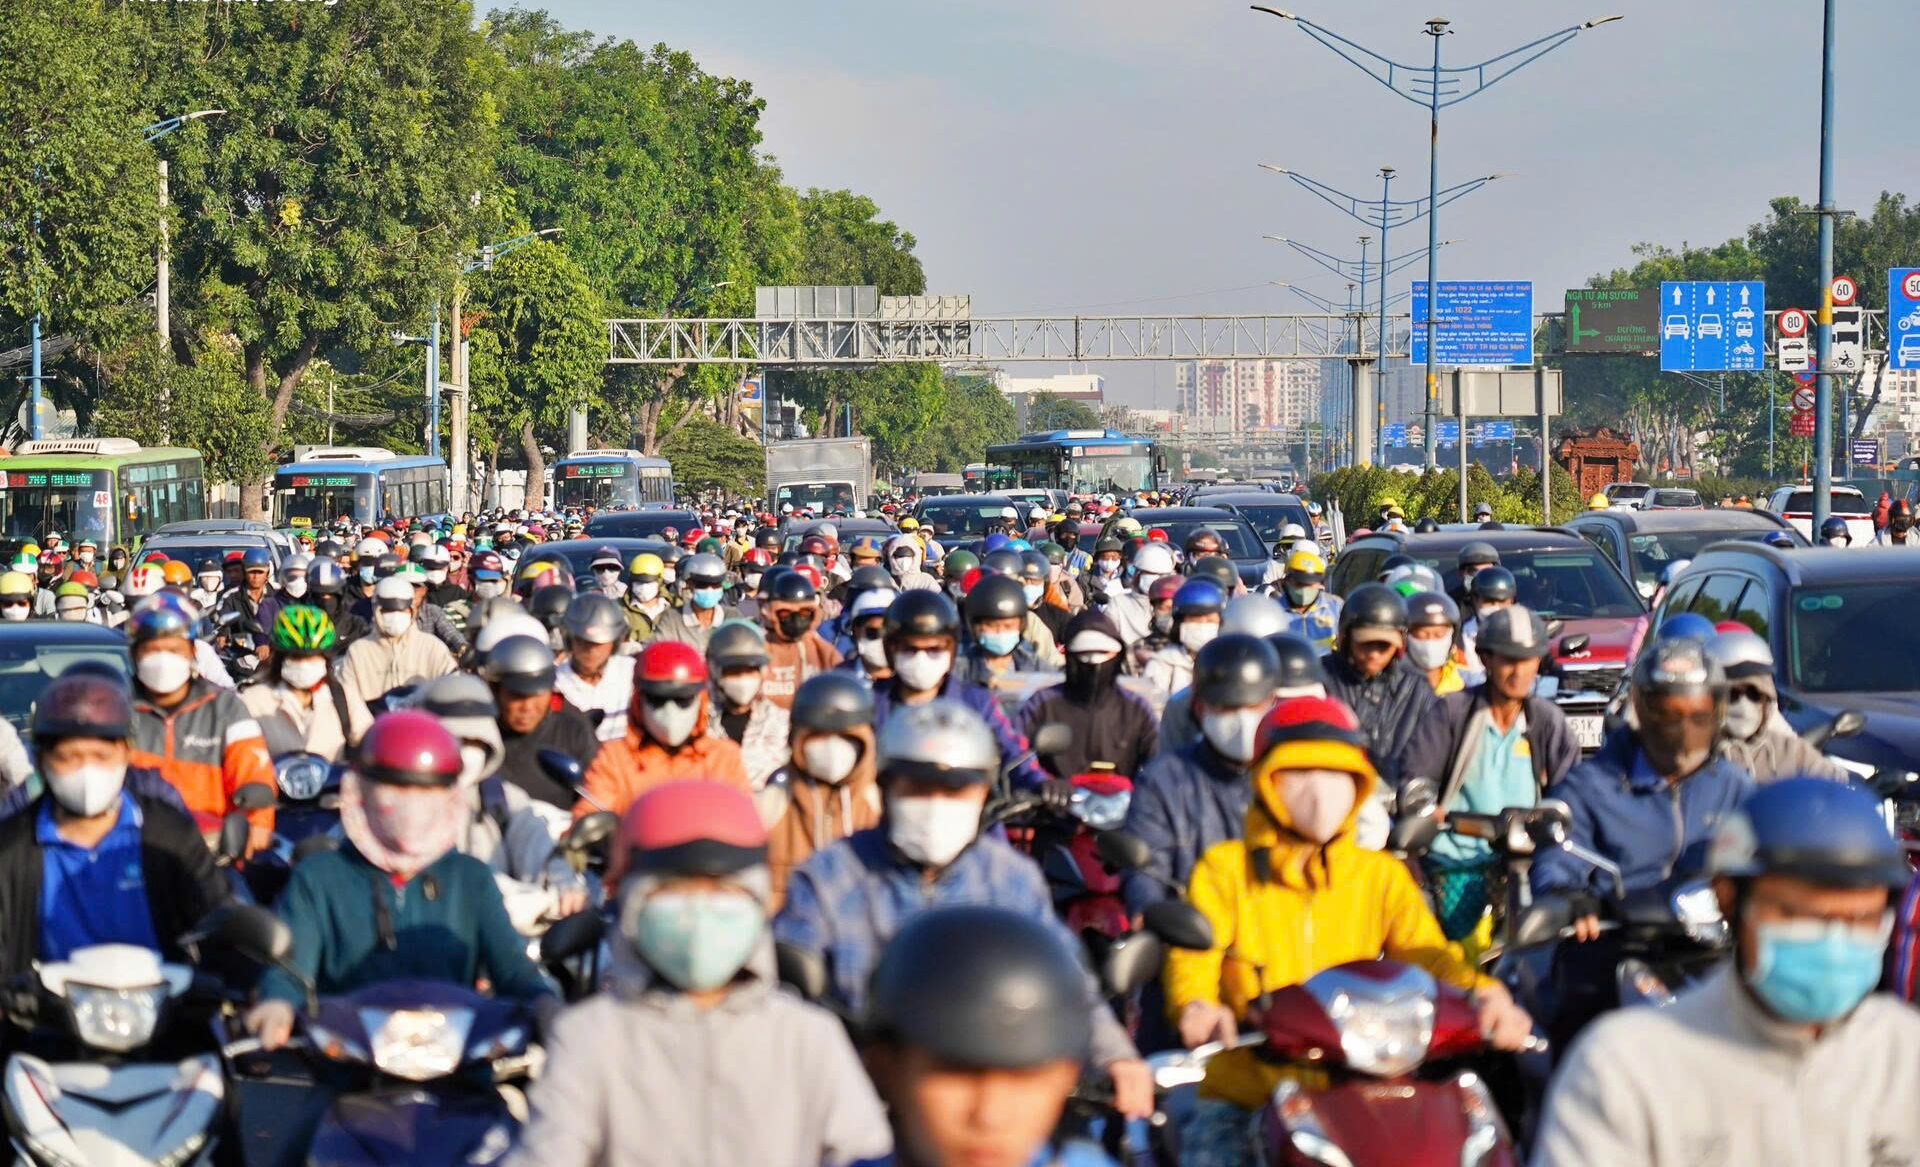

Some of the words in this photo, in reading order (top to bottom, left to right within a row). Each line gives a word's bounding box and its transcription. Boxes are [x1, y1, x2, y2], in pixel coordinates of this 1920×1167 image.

[1836, 284, 1849, 295] 60
[1910, 280, 1920, 292] 50
[1455, 306, 1472, 314] 1022
[1787, 316, 1799, 328] 80
[96, 493, 109, 503] 48
[1571, 718, 1594, 731] 51K
